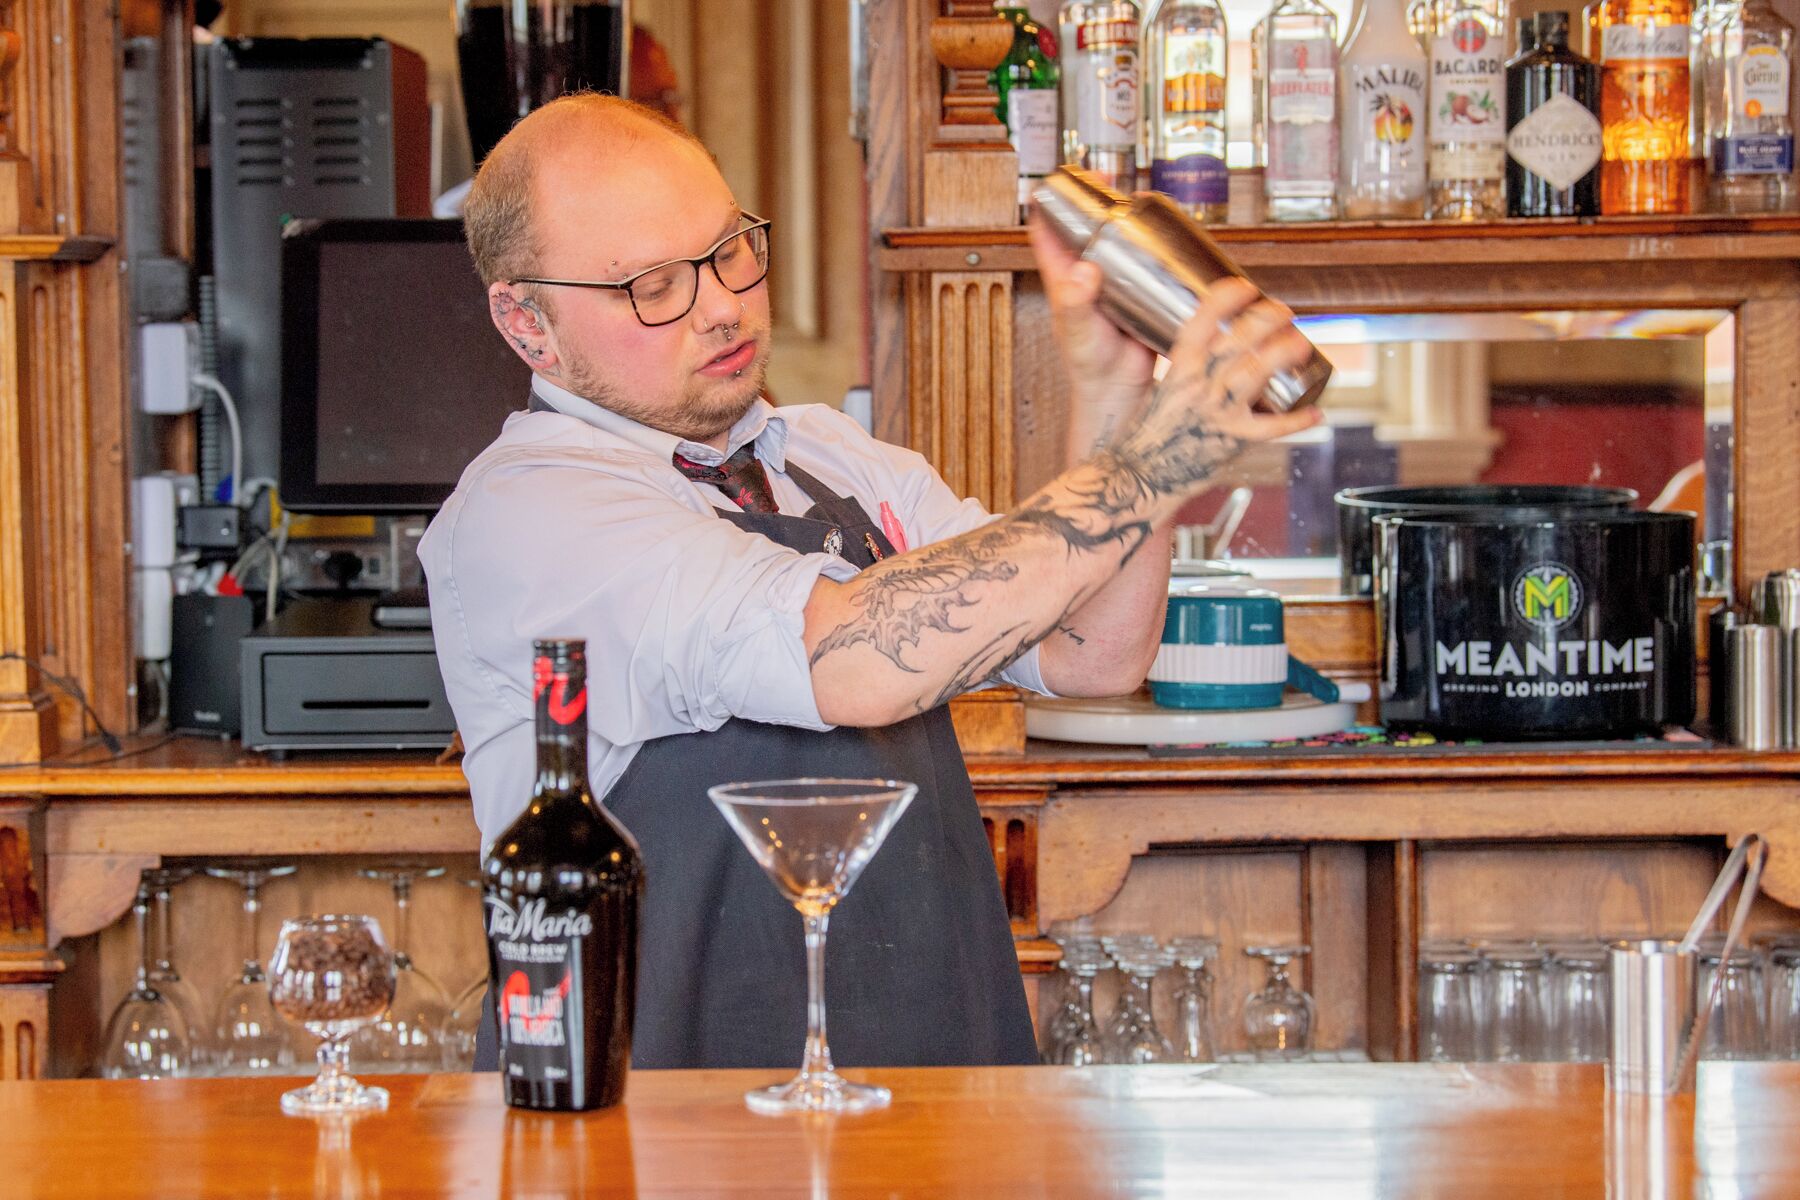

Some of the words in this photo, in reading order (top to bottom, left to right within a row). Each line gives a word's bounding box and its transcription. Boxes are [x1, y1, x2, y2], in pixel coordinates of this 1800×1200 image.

[1435, 637, 1655, 677] MEANTIME
[1442, 683, 1499, 694] BREWING
[1505, 680, 1590, 698] LONDON
[1593, 681, 1649, 692] COMPANY
[508, 896, 593, 942] Maria
[530, 942, 568, 956] BREW
